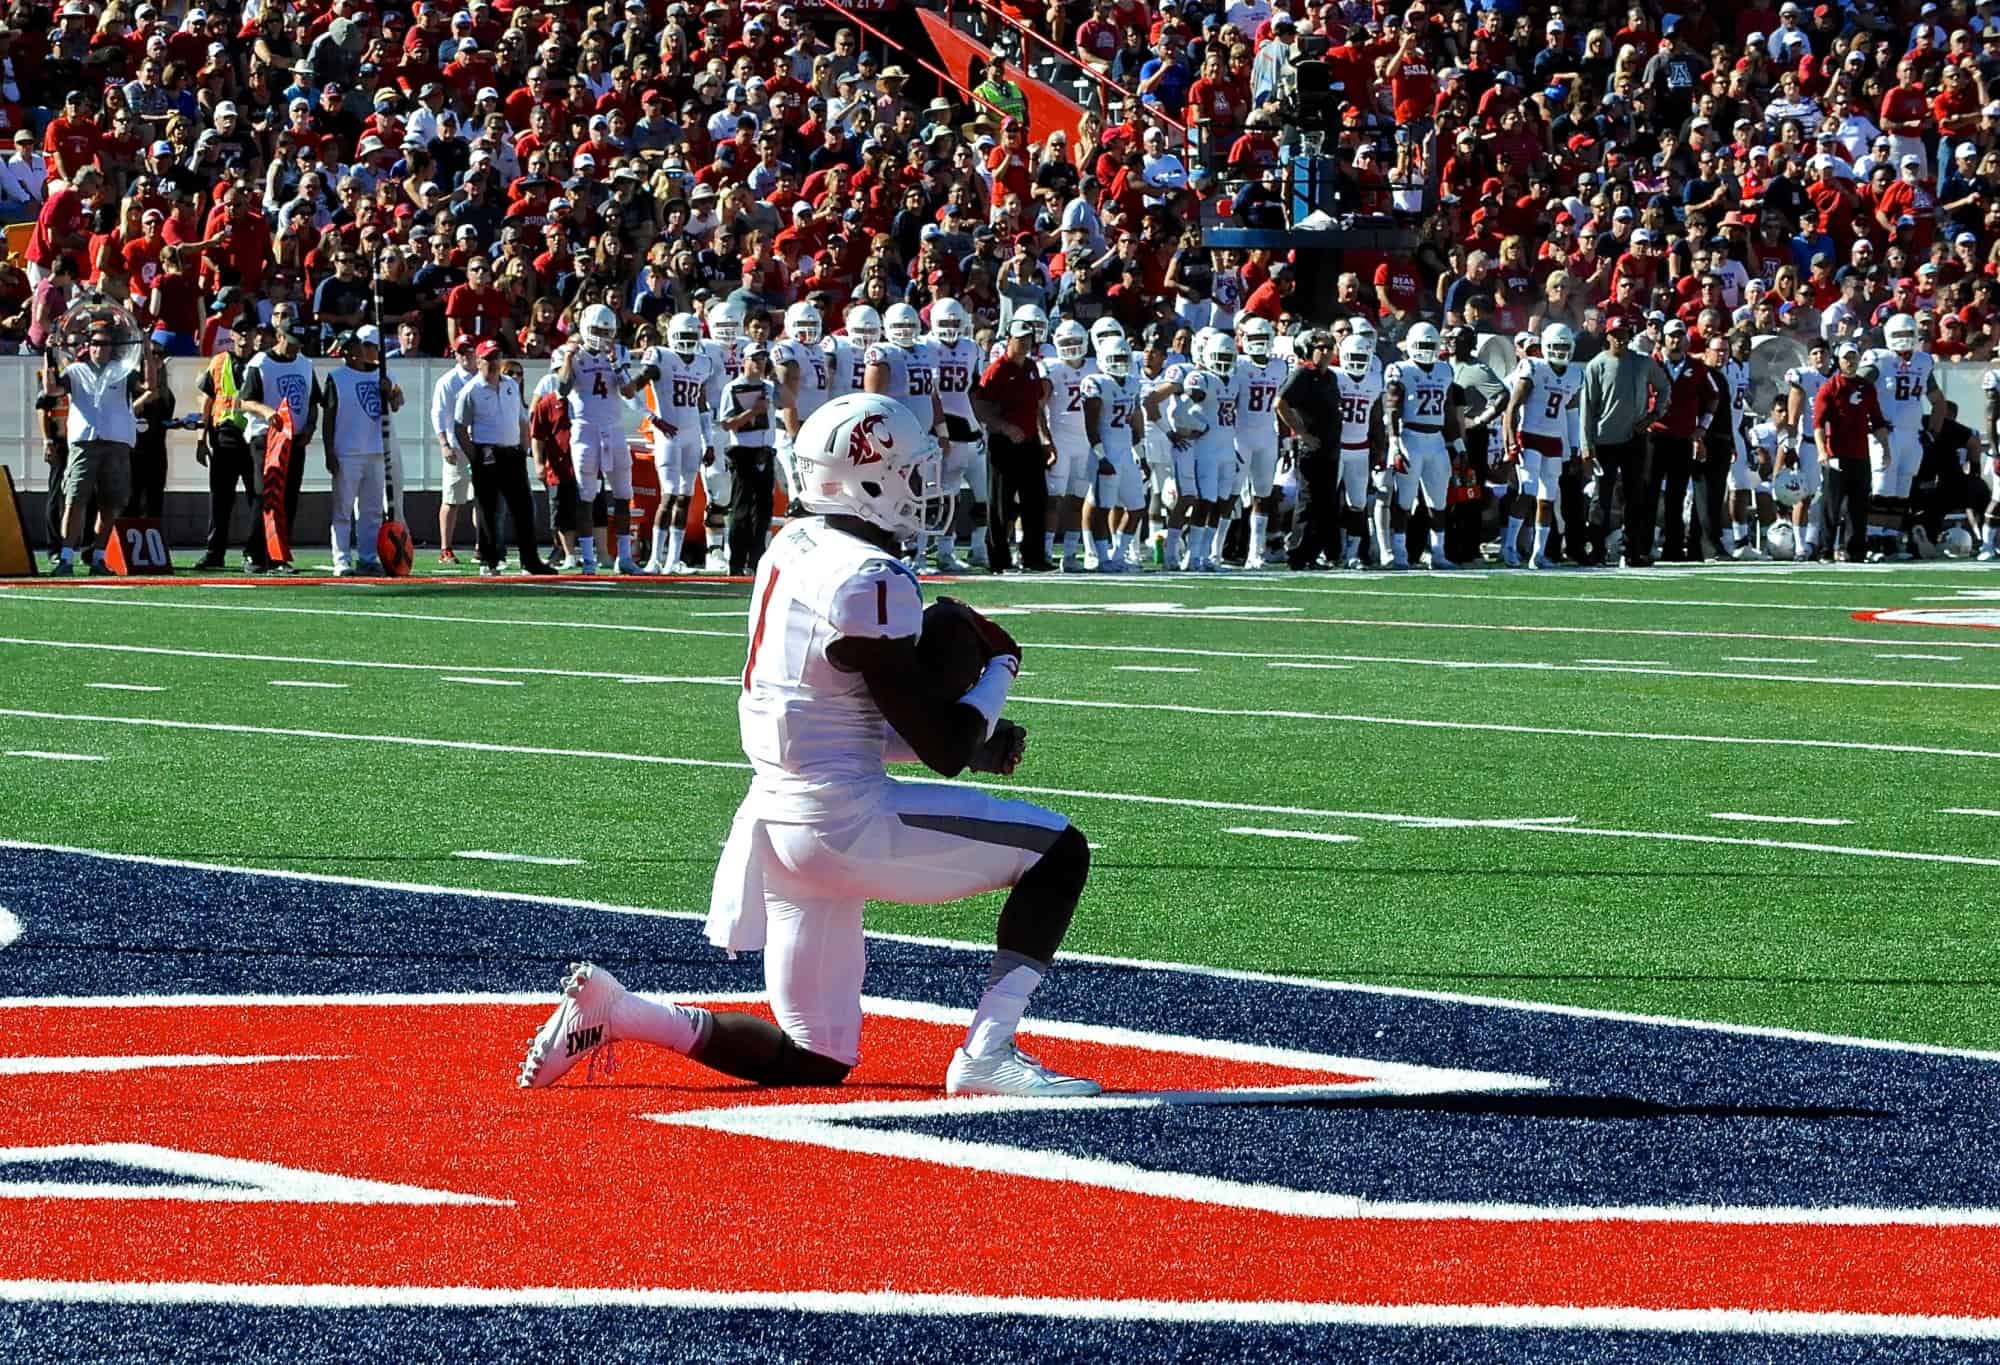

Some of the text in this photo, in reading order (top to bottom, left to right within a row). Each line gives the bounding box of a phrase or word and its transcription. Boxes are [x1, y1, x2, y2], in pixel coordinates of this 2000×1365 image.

[592, 372, 608, 399] 4
[908, 368, 932, 396] 58
[939, 366, 968, 392] 63
[1895, 376, 1922, 400] 64
[673, 380, 699, 407] 80
[1249, 386, 1277, 412] 87
[1416, 390, 1444, 416] 23
[126, 528, 166, 567] 20
[875, 580, 888, 625] 1
[566, 1024, 603, 1058] NIKE
